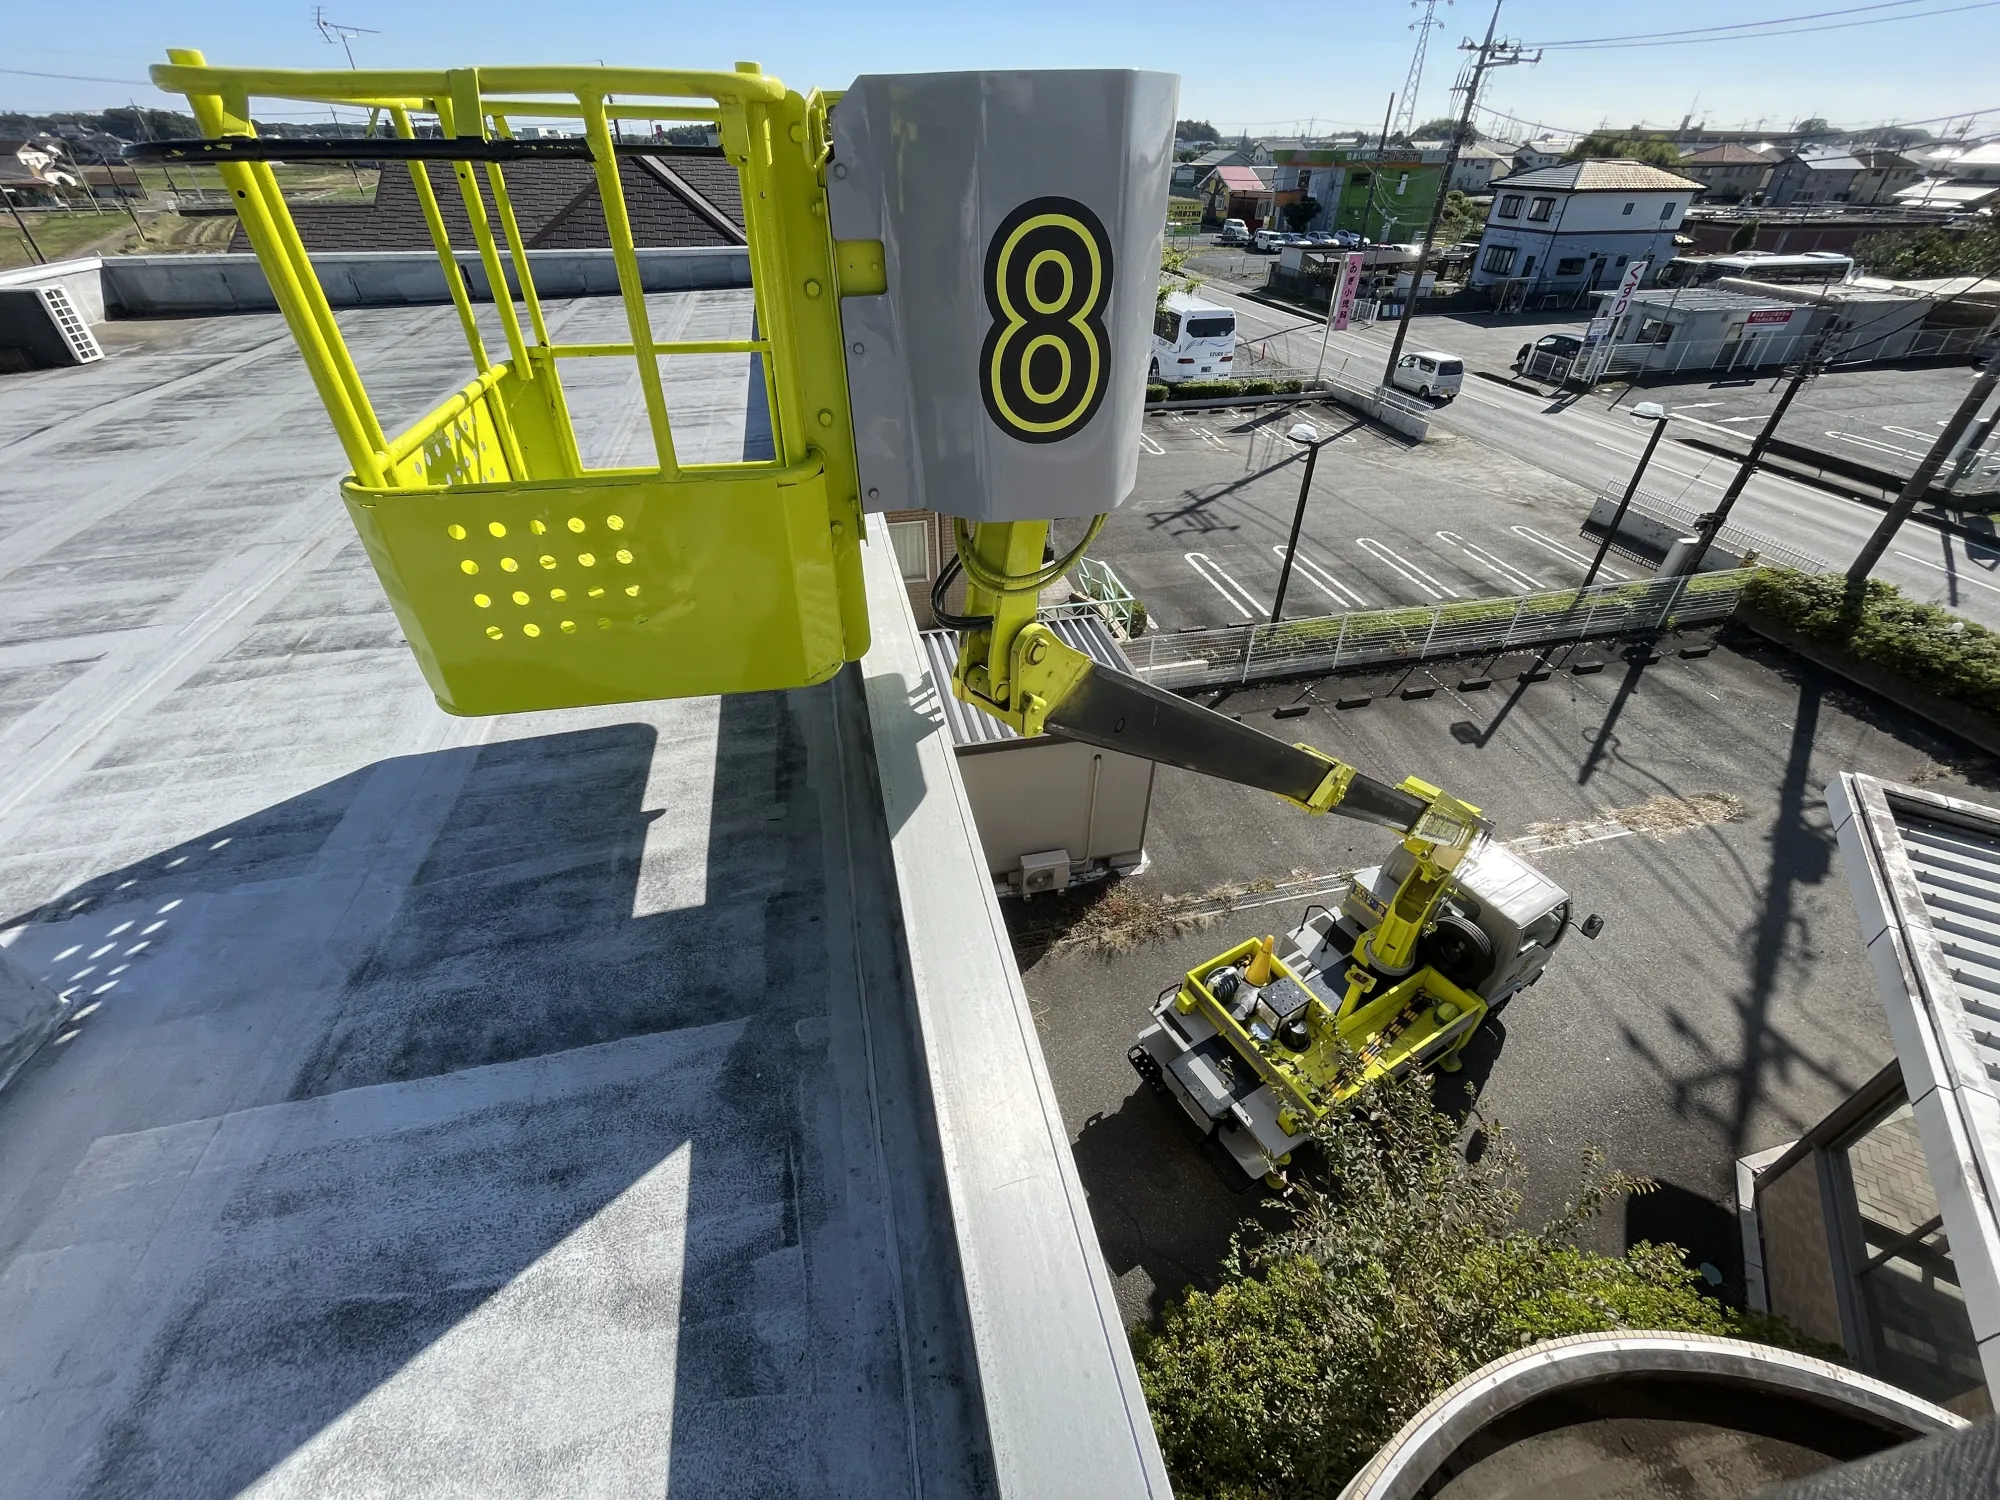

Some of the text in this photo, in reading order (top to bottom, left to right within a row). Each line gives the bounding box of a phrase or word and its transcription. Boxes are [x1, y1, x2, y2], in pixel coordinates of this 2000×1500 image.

[979, 196, 1113, 444] 8
[1614, 263, 1644, 316] くすり
